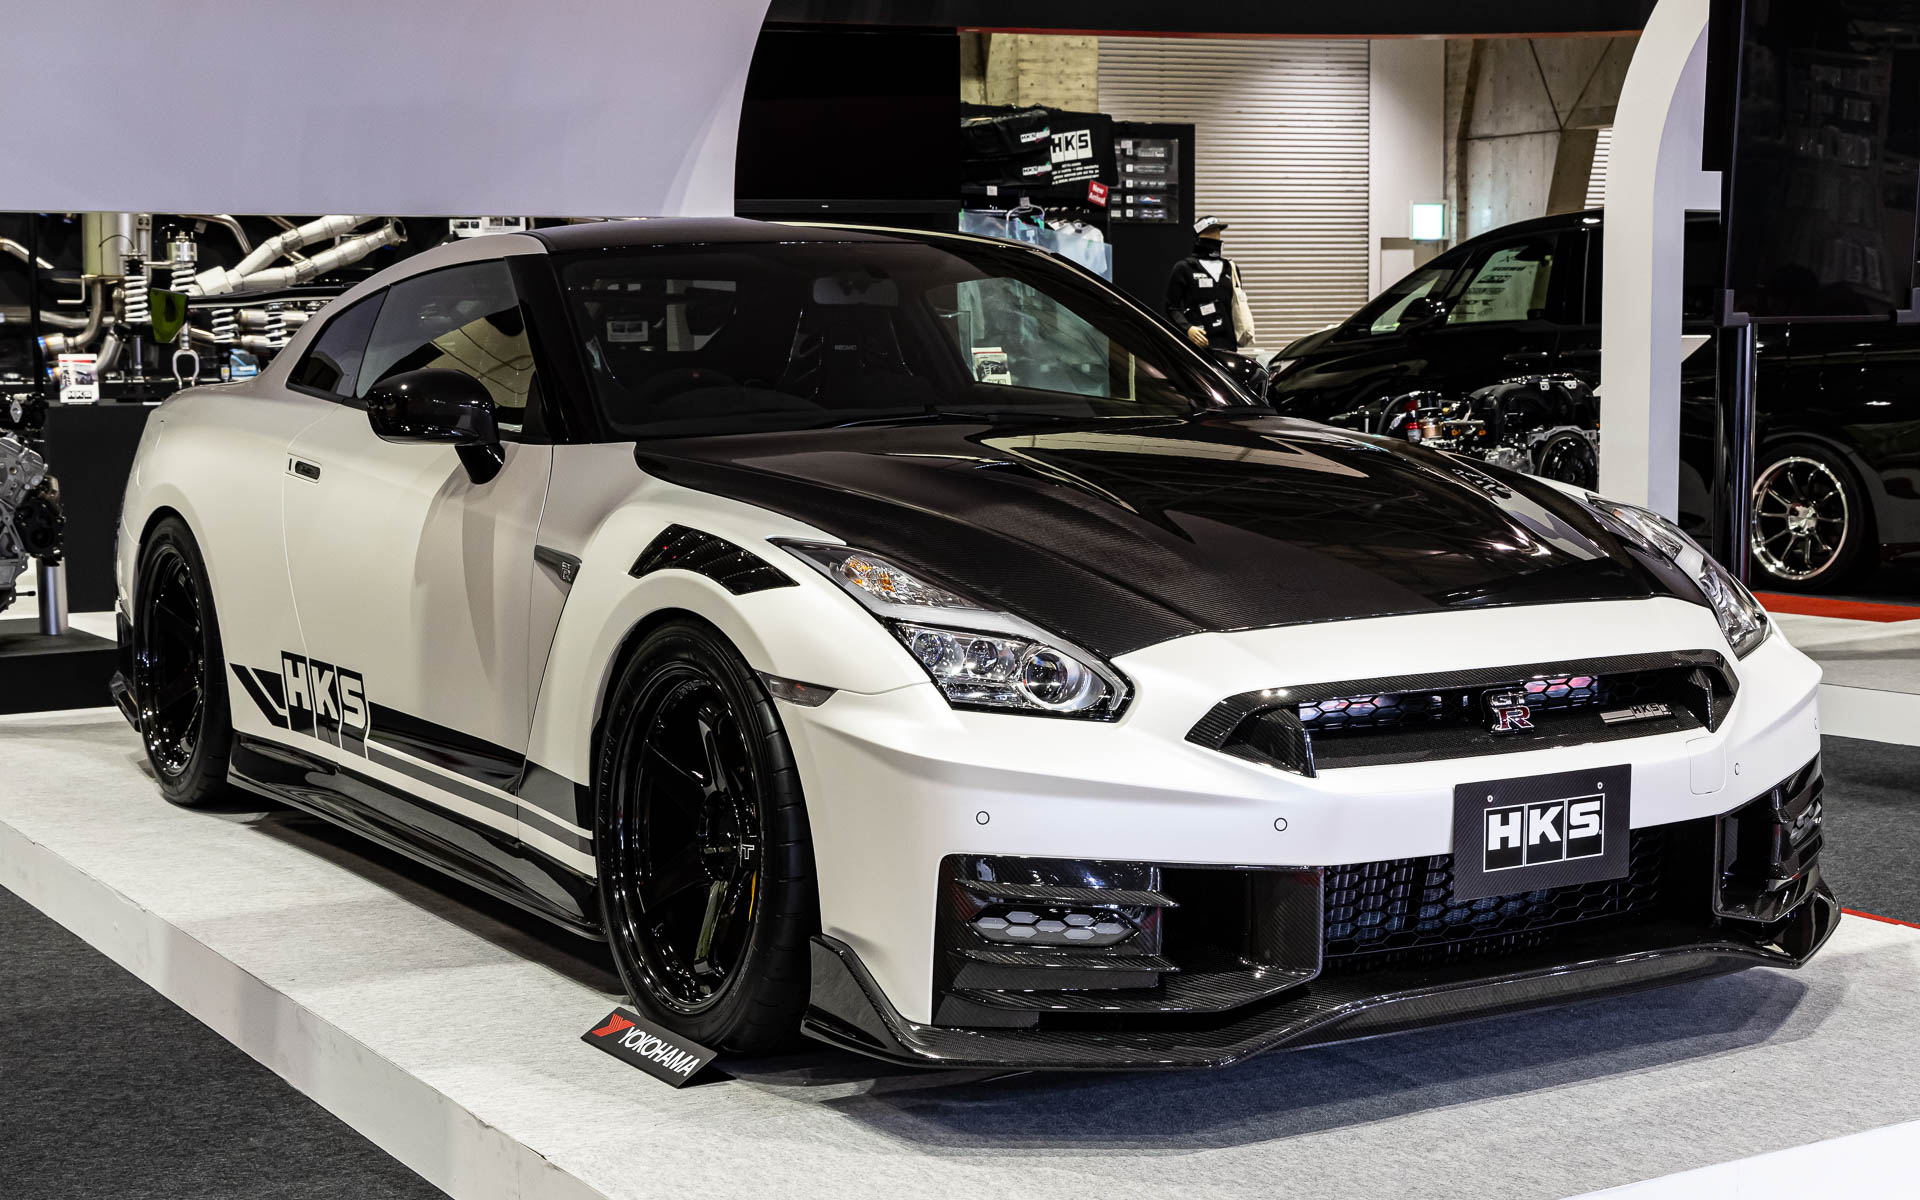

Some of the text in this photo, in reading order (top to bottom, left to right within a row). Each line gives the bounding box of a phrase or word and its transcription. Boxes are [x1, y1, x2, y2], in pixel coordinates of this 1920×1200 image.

[1051, 133, 1089, 154] HKS
[1092, 184, 1105, 195] New
[283, 658, 366, 729] HKS
[1631, 703, 1661, 716] HKS
[1487, 801, 1601, 851] HKS
[617, 1026, 701, 1077] YOKOHAMA
